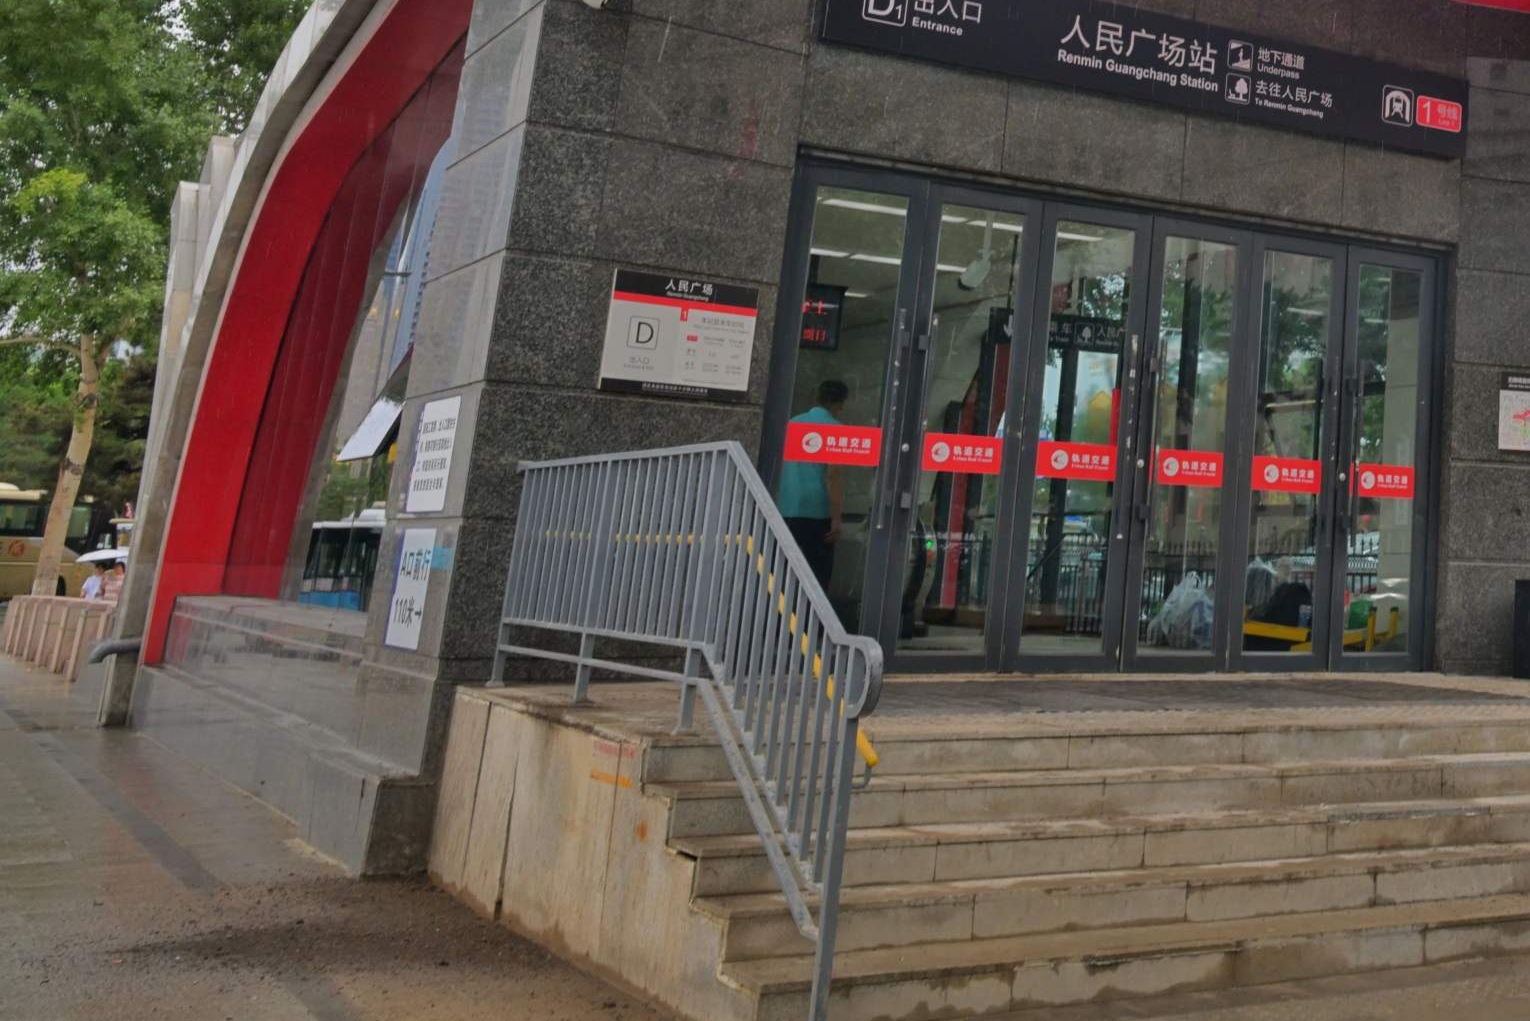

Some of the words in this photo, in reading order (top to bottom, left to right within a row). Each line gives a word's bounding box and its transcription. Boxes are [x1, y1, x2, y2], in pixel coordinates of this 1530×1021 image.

[911, 16, 964, 37] Entrance
[1060, 14, 1218, 75] 人民广场站
[1257, 46, 1305, 69] 地下通道
[1057, 48, 1103, 69] Renmin
[1105, 58, 1178, 87] Guangchang
[1179, 72, 1219, 92] Station
[1256, 61, 1300, 79] Underpass
[1255, 79, 1333, 108] 去往人民广场
[664, 278, 714, 296] 人民广场
[635, 321, 655, 344] D
